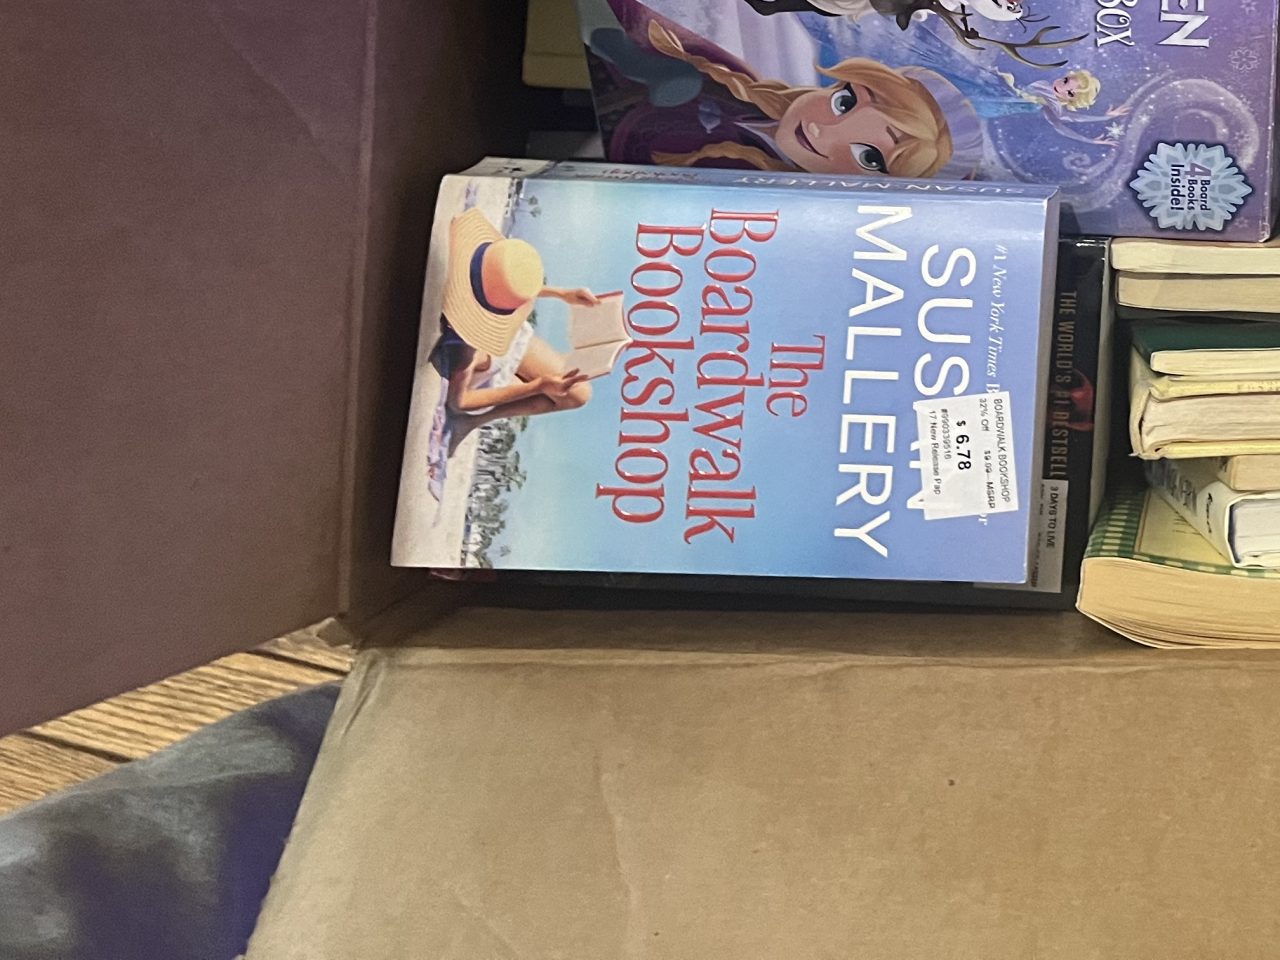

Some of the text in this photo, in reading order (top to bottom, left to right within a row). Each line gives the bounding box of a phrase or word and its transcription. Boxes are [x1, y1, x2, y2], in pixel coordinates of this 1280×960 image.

[1170, 164, 1186, 211] Inside!
[1184, 162, 1211, 211] 4 Board
[1187, 179, 1198, 211] Books
[992, 264, 1007, 298] New
[1058, 290, 1077, 315] THE
[989, 302, 1006, 333] York
[595, 222, 707, 526] Bookshop
[766, 334, 826, 418] The
[986, 336, 1003, 378] Times
[1055, 321, 1075, 383] WORLD'S
[684, 207, 782, 546] Boardwalk
[833, 204, 914, 559] MALLERY
[907, 244, 977, 509] SUS
[931, 442, 940, 476] Release
[956, 434, 971, 471] 6.78
[993, 398, 1011, 503] BOARDWALK BOOKSHOP
